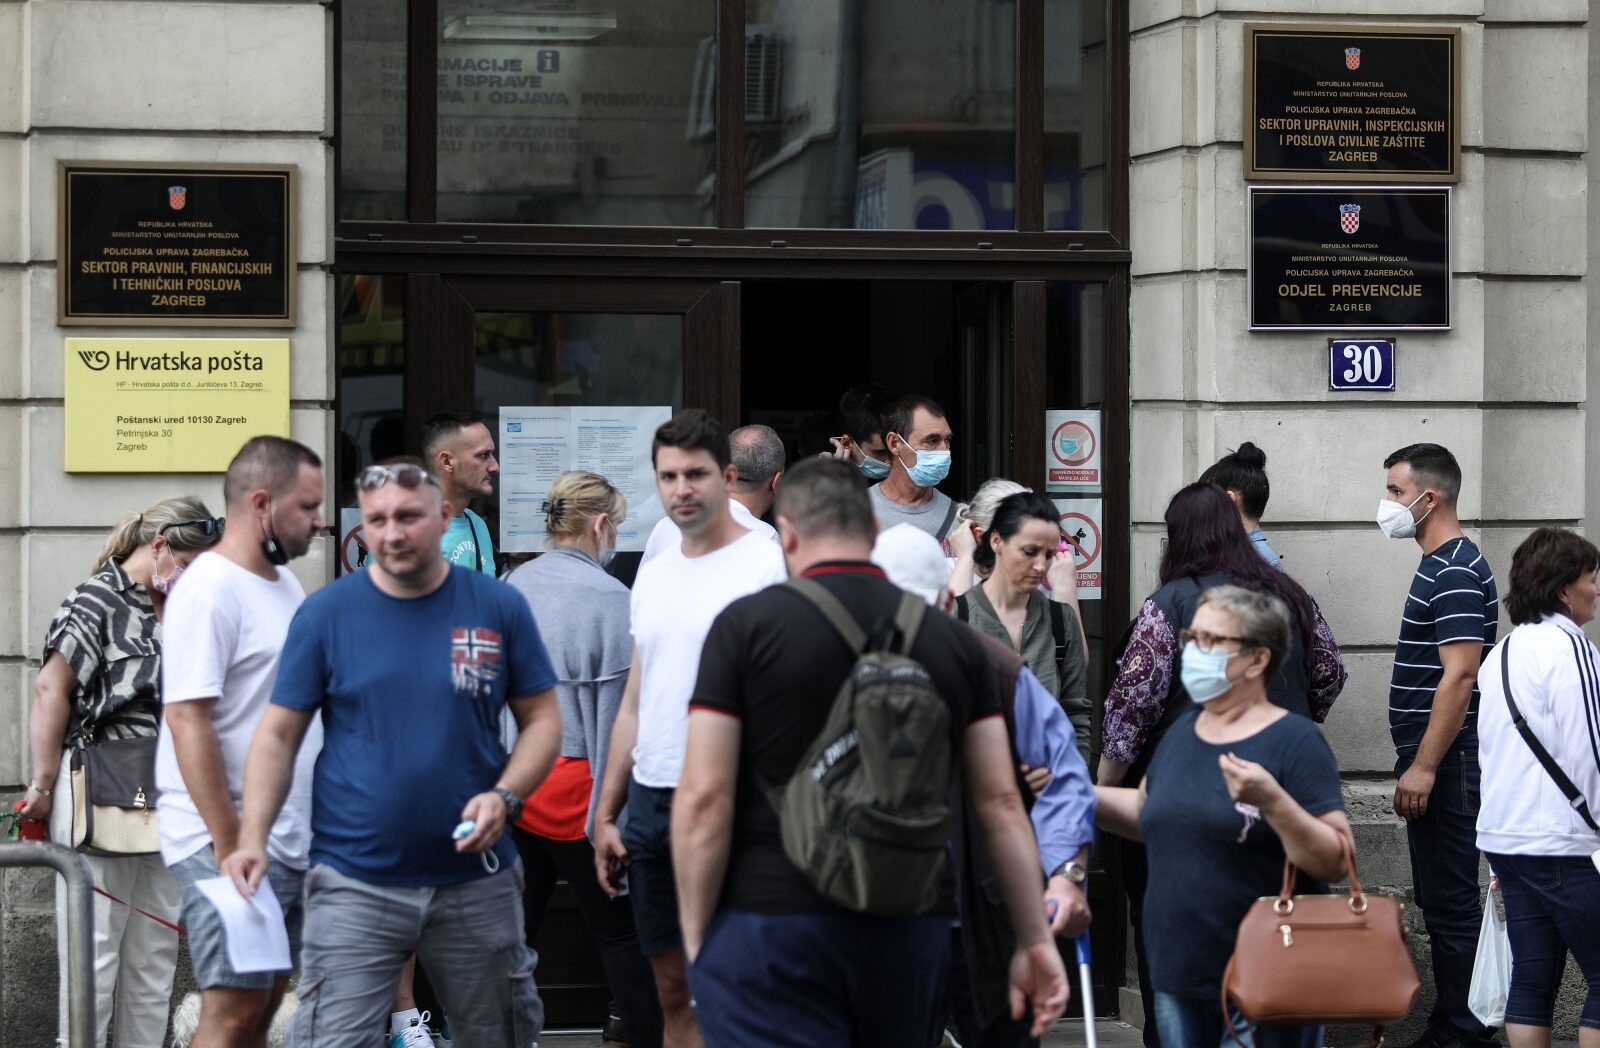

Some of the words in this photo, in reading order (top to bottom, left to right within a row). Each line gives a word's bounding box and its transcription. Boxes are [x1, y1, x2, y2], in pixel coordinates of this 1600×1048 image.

[456, 74, 542, 88] ISPRAVE
[488, 90, 568, 104] ODJAVA
[1286, 106, 1330, 114] POLICIJSKA
[1332, 106, 1363, 114] UPRAVA
[1365, 106, 1416, 115] ZAGREBAČKA
[1260, 118, 1301, 130] SEKTOR
[1304, 119, 1362, 132] UPRAVNIH,
[1366, 120, 1445, 132] INSPEKCIJSKIH
[1280, 135, 1283, 146] I
[1286, 135, 1336, 147] POSLOVA
[1338, 136, 1380, 148] CIVILNE
[1382, 134, 1426, 148] ZAŠTITE
[1328, 151, 1378, 162] ZAGREB
[104, 248, 154, 256] POLICIJSKA
[156, 248, 190, 256] UPRAVA
[192, 246, 249, 257] ZAGREBAČKA
[82, 261, 129, 274] SEKTOR
[132, 262, 188, 276] PRAVNIH,
[191, 262, 272, 275] FINANCIJSKIH
[1364, 268, 1414, 276] ZAGREBAČKA
[113, 278, 118, 290] I
[120, 275, 184, 291] TEHNIČKIH
[187, 279, 242, 291] POSLOVA
[1278, 284, 1326, 297] ODJEL
[1332, 284, 1422, 297] PREVENCIJE
[152, 295, 206, 306] ZAGREB
[1330, 304, 1372, 312] ZAGREB
[116, 351, 202, 371] Hrvatska
[208, 350, 263, 374] pošta
[1344, 344, 1382, 383] 30
[162, 381, 180, 389] pošta
[116, 414, 162, 424] Poštanski
[164, 416, 184, 424] ured
[188, 416, 214, 424] 10130
[216, 416, 247, 426] Zagreb
[116, 429, 158, 440] Petrinjska
[161, 429, 172, 438] 30
[116, 442, 148, 452] Zagreb
